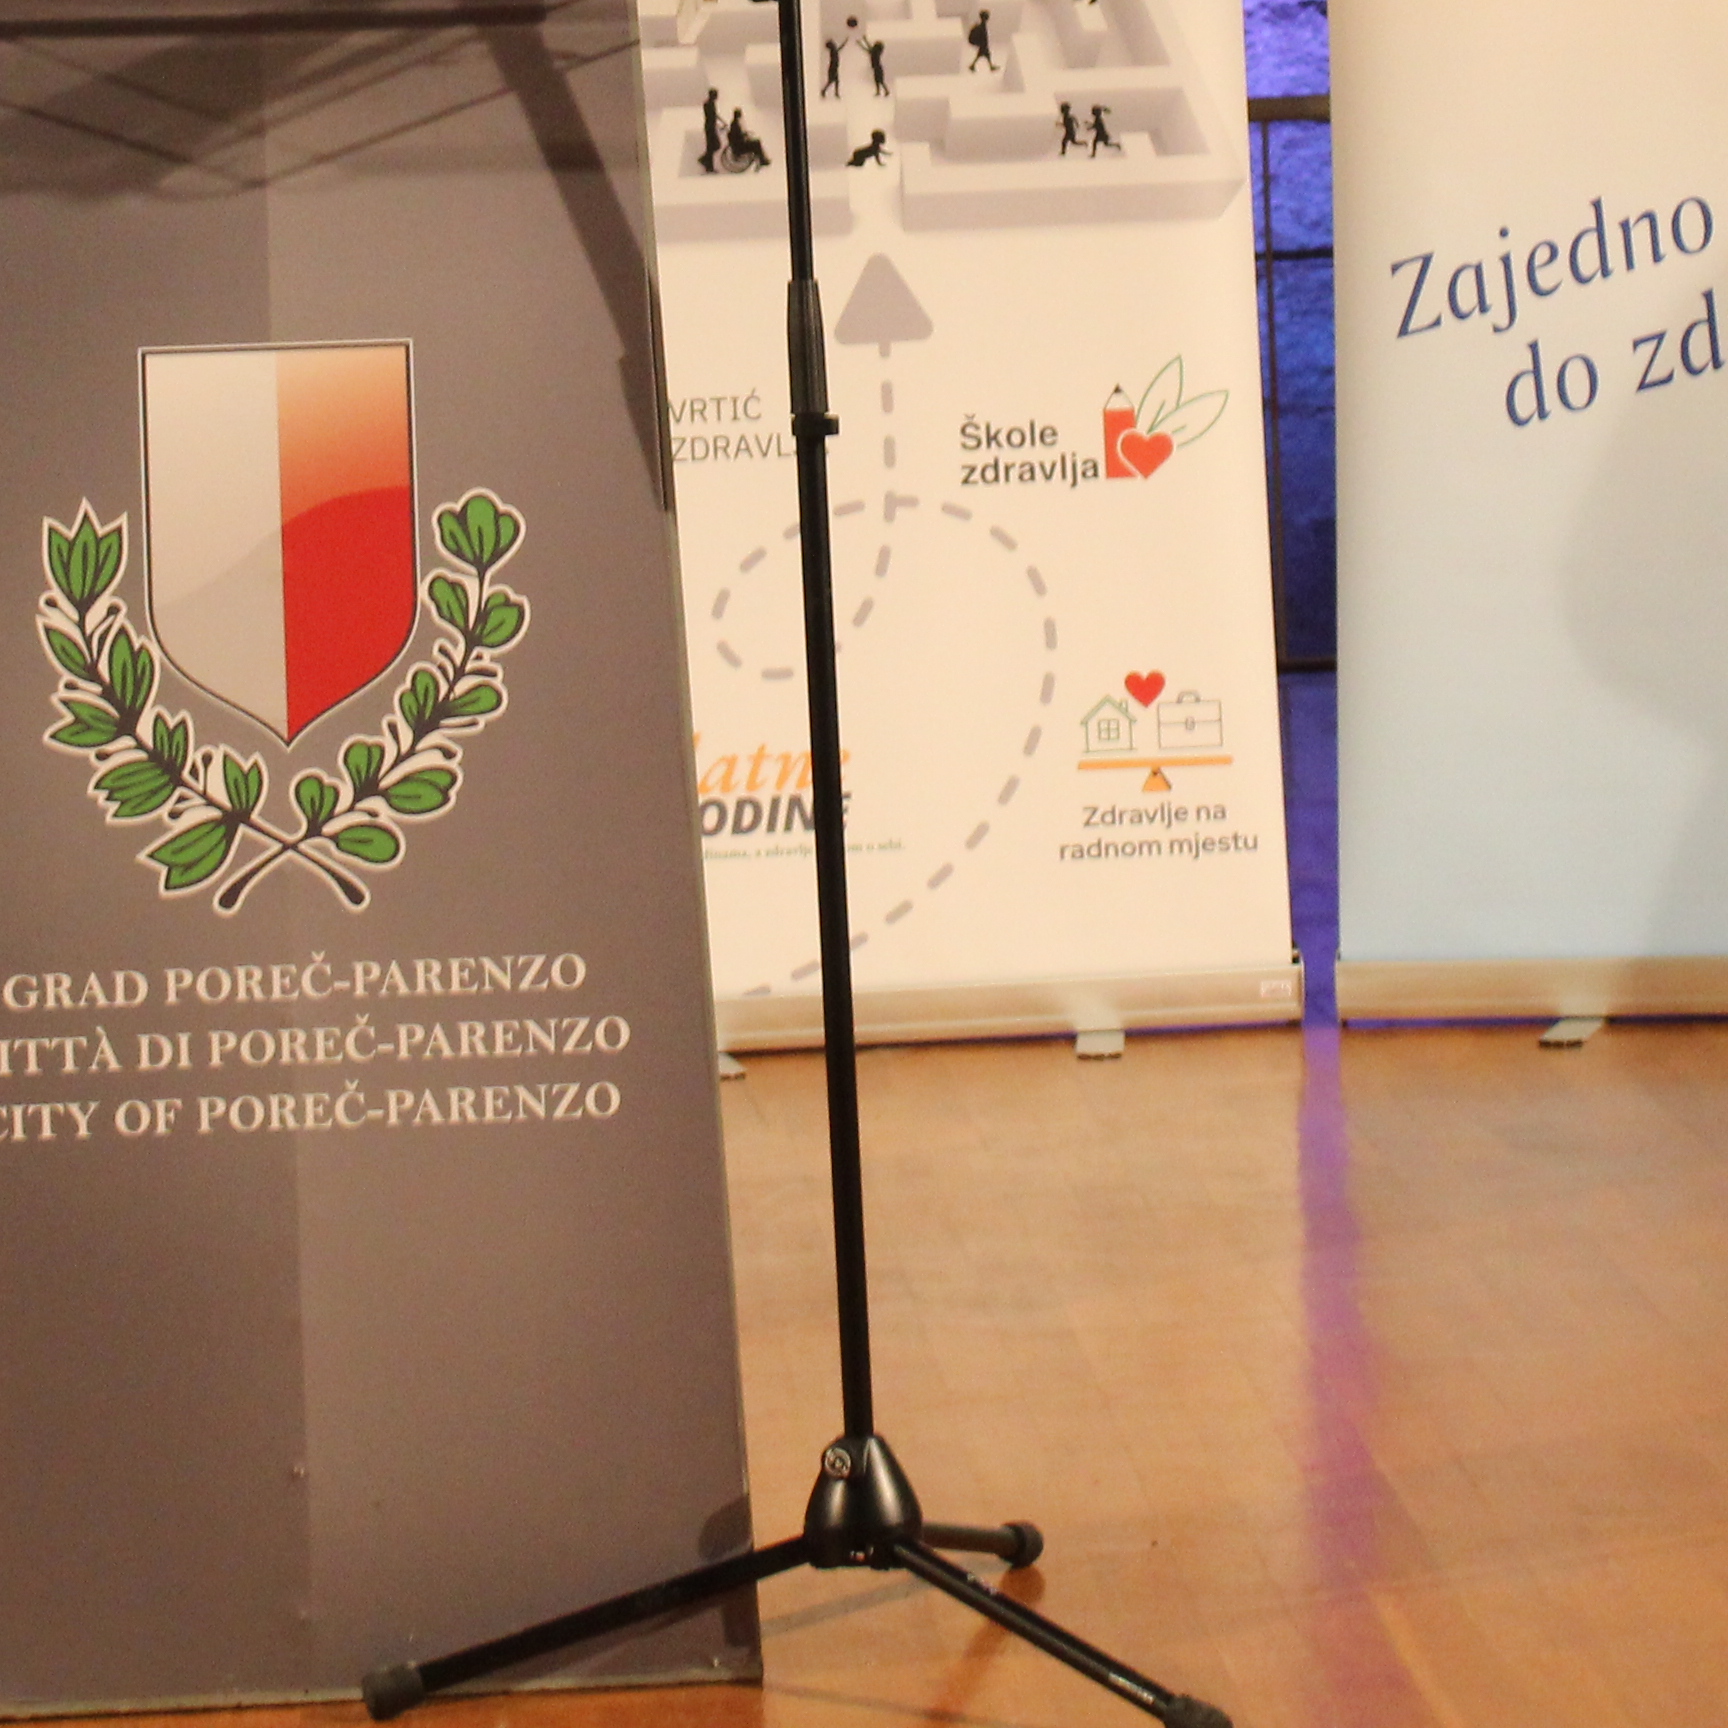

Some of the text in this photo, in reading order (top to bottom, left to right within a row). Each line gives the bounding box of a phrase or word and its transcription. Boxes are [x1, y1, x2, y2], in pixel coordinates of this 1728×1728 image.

[1389, 196, 1714, 338] Zajedno
[1504, 340, 1599, 427] do
[961, 415, 1059, 449] Škole
[960, 452, 1101, 488] zdravlja
[1082, 802, 1227, 829] Zdravlje na
[1059, 831, 1258, 861] radnom mjestu
[3, 951, 587, 1012] GRAD POREČ-PARENZO
[138, 1032, 191, 1070] DI
[208, 1013, 631, 1067] POREČ-PARENZO
[114, 1099, 181, 1135] OF
[197, 1079, 621, 1133] POREČ-PARENZO
